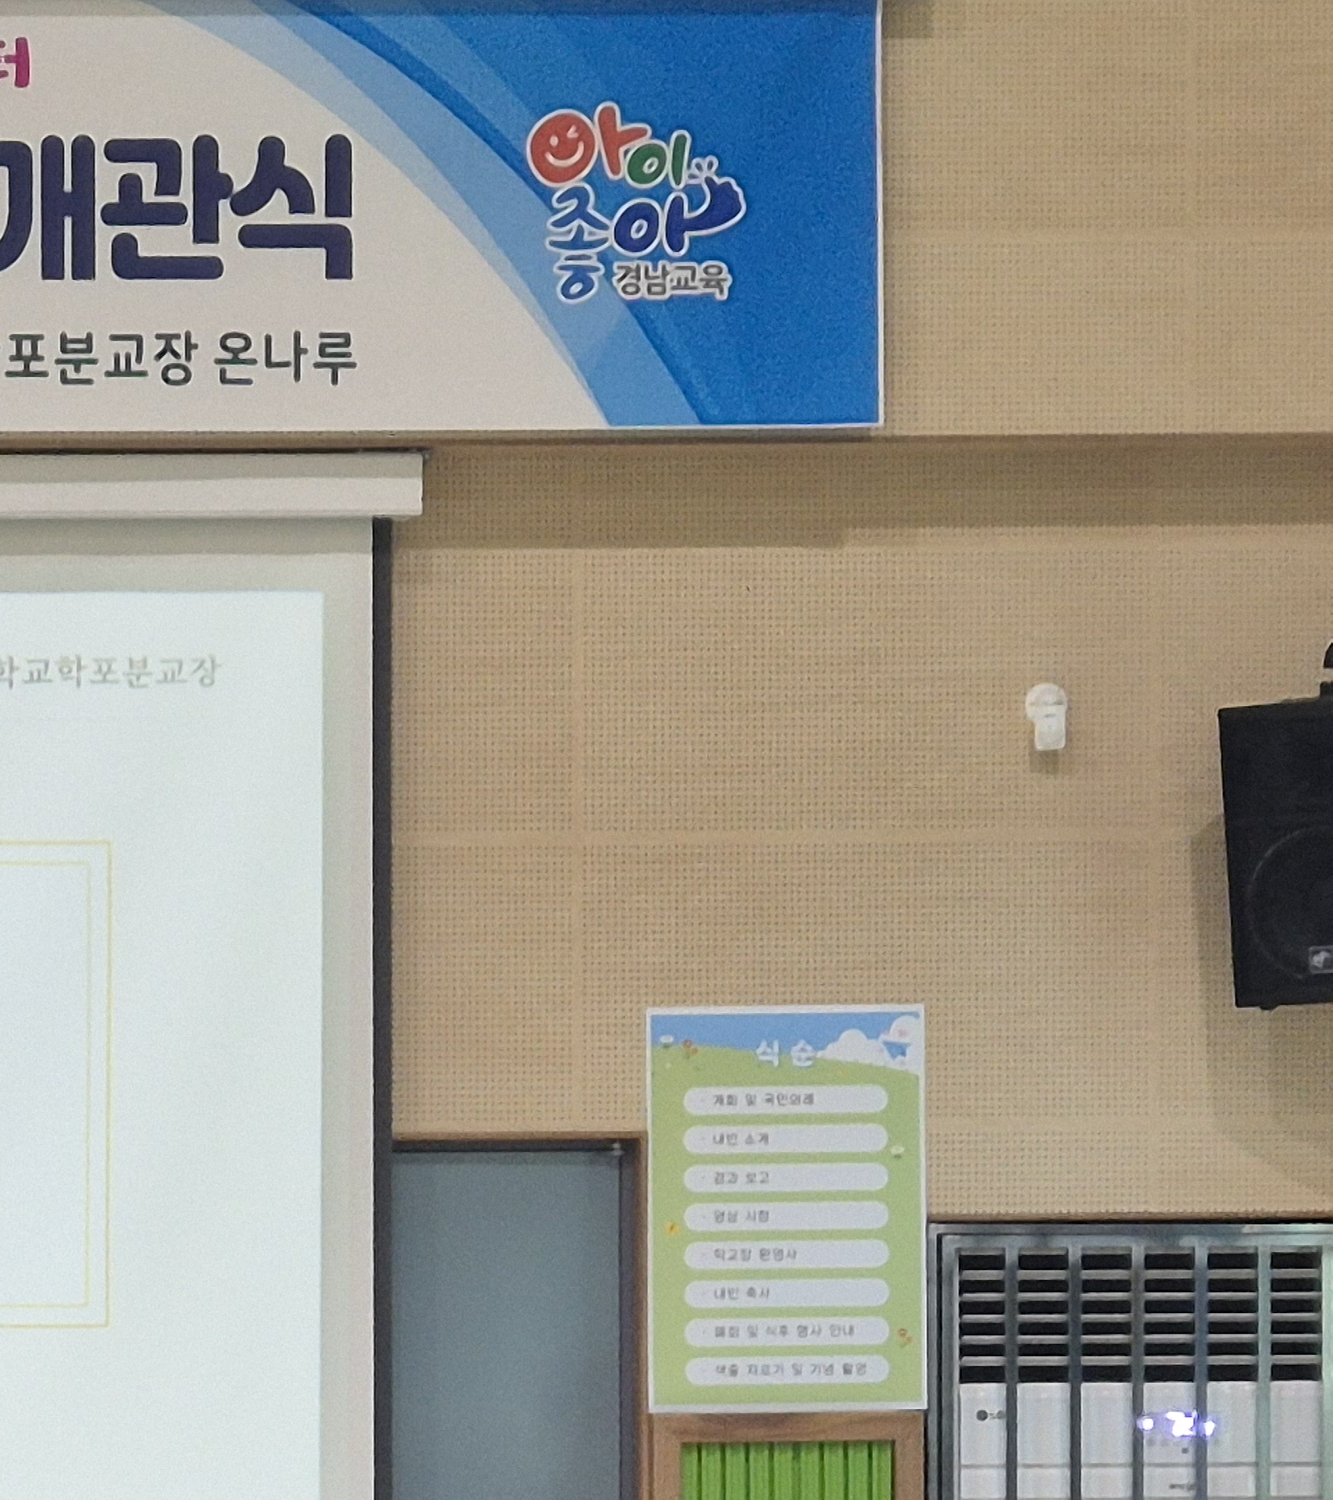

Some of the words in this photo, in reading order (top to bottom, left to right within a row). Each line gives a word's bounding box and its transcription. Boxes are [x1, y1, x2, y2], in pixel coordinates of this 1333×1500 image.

[528, 103, 690, 187] 아이
[547, 184, 745, 302] 좋아
[615, 263, 729, 298] 경남교육
[214, 331, 357, 385] 온나루
[713, 1133, 737, 1146] 내빈
[745, 1133, 769, 1145] 소개
